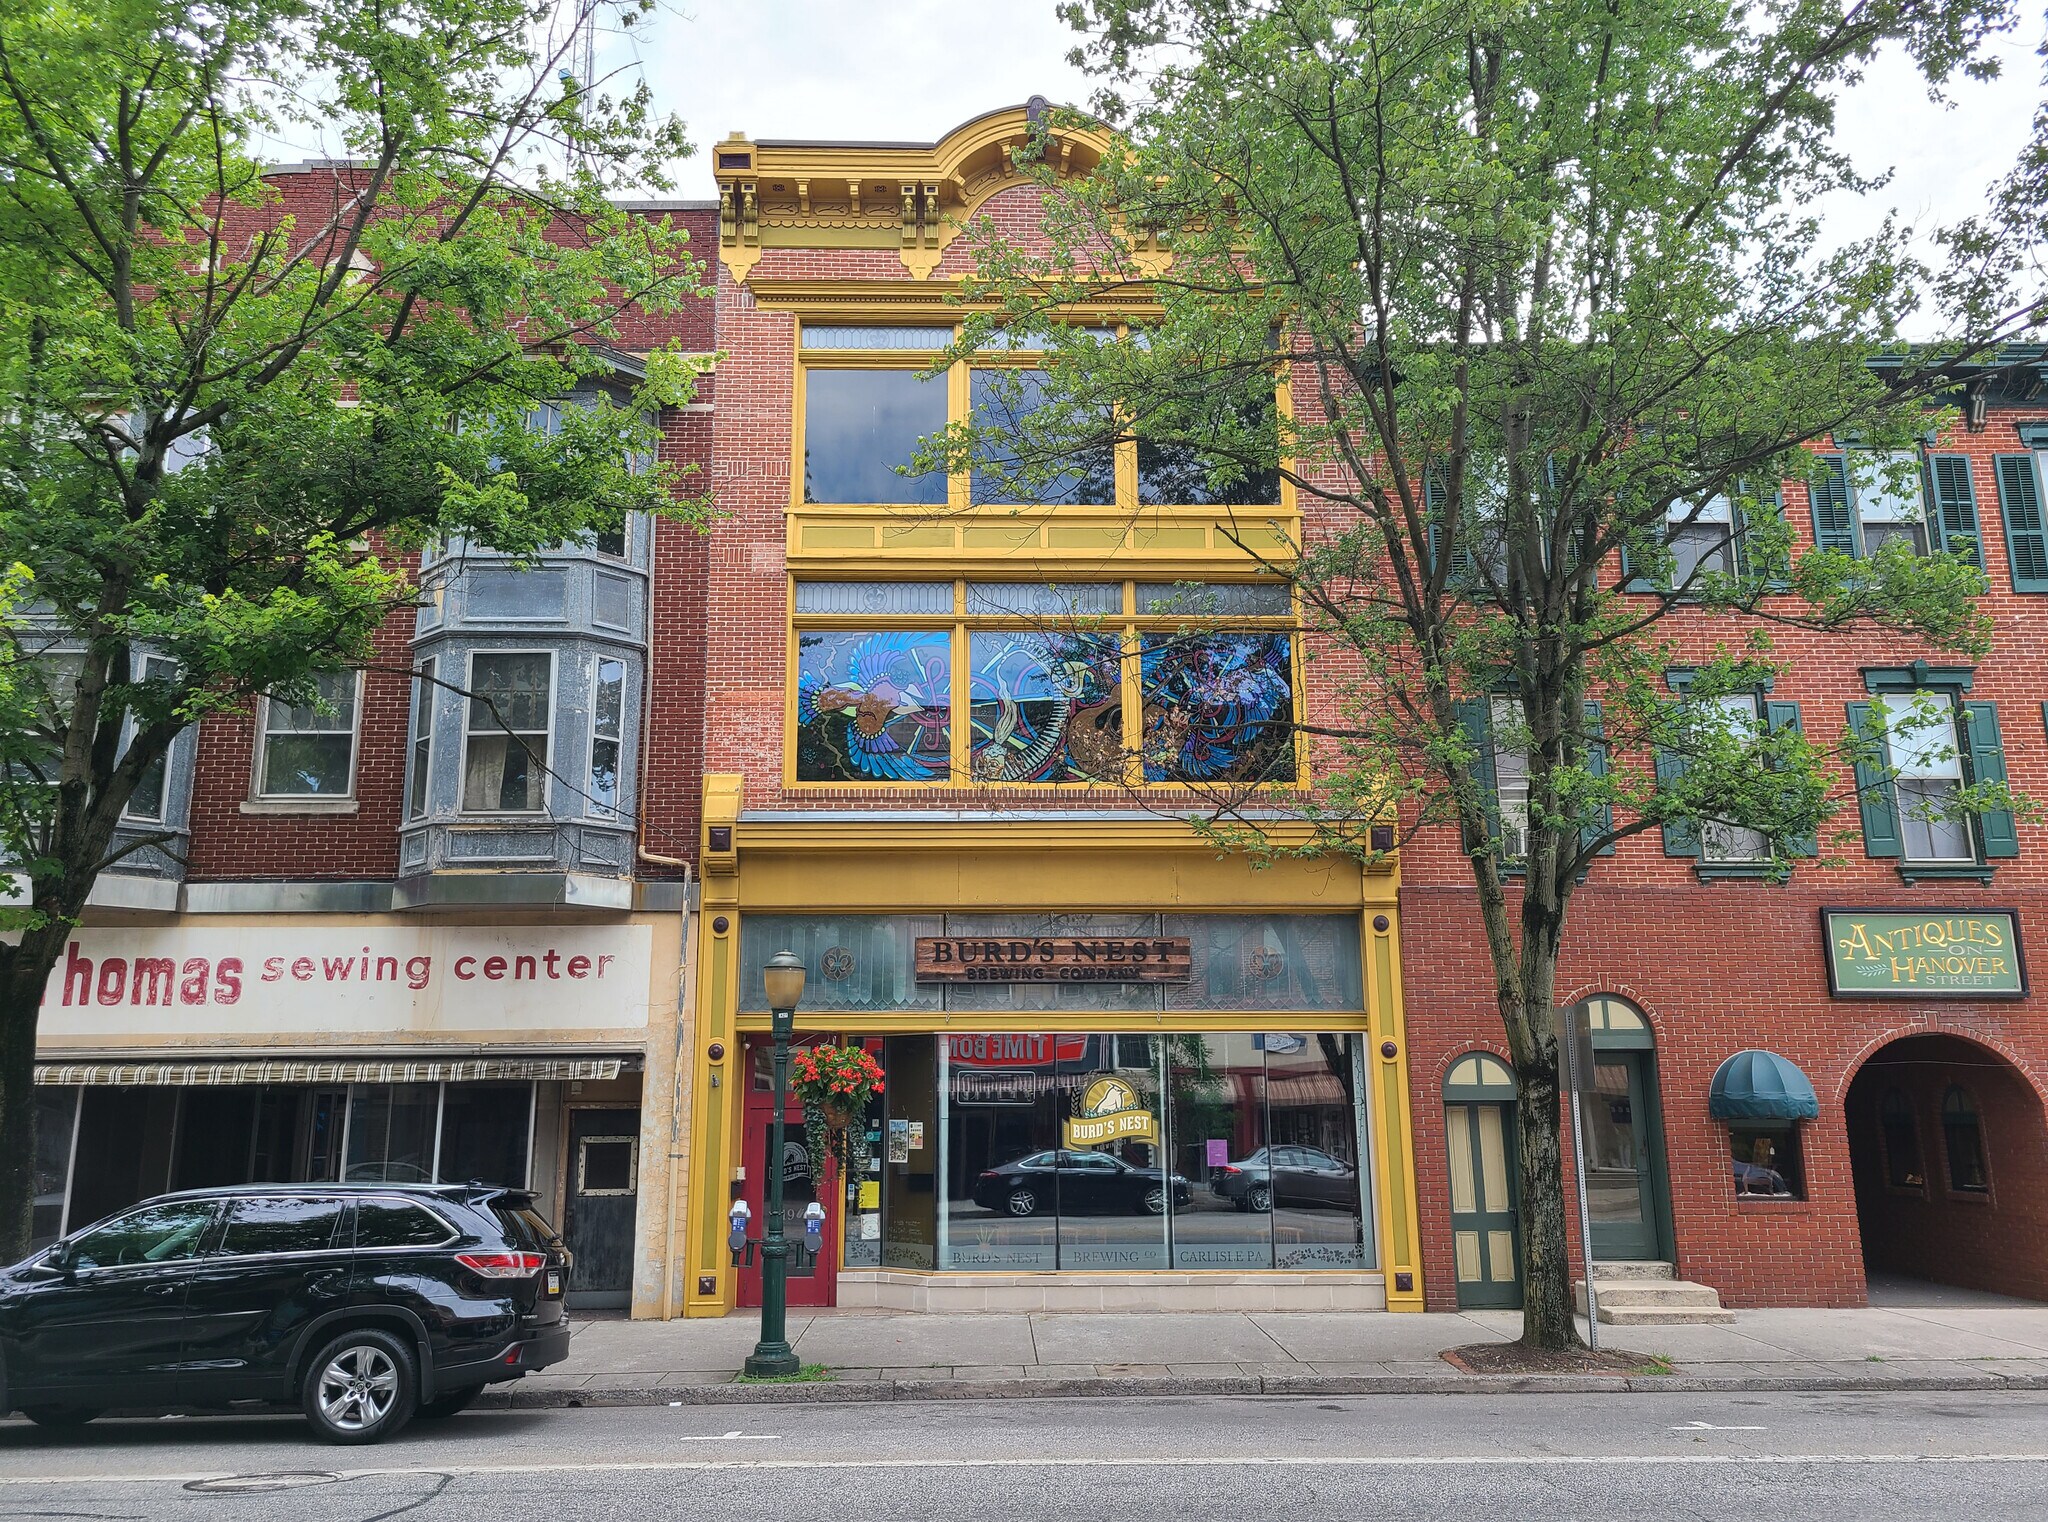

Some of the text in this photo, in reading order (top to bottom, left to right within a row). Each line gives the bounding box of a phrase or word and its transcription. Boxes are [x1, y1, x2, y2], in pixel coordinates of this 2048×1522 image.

[932, 938, 1175, 962] BURD'S NEST
[1839, 919, 2003, 960] ANTIQUES
[1948, 945, 1984, 956] ON
[40, 941, 615, 1006] homas sewing center
[966, 967, 1142, 980] BREWING COMPANY
[1889, 956, 2009, 983] HANOVER
[1926, 975, 1995, 985] STREET
[1073, 1116, 1149, 1139] BURD'S NEST
[952, 1252, 1000, 1263] BURD'S
[1006, 1252, 1042, 1263] NEST
[1074, 1251, 1139, 1263] BREWING
[1180, 1250, 1243, 1262] CARLISLE
